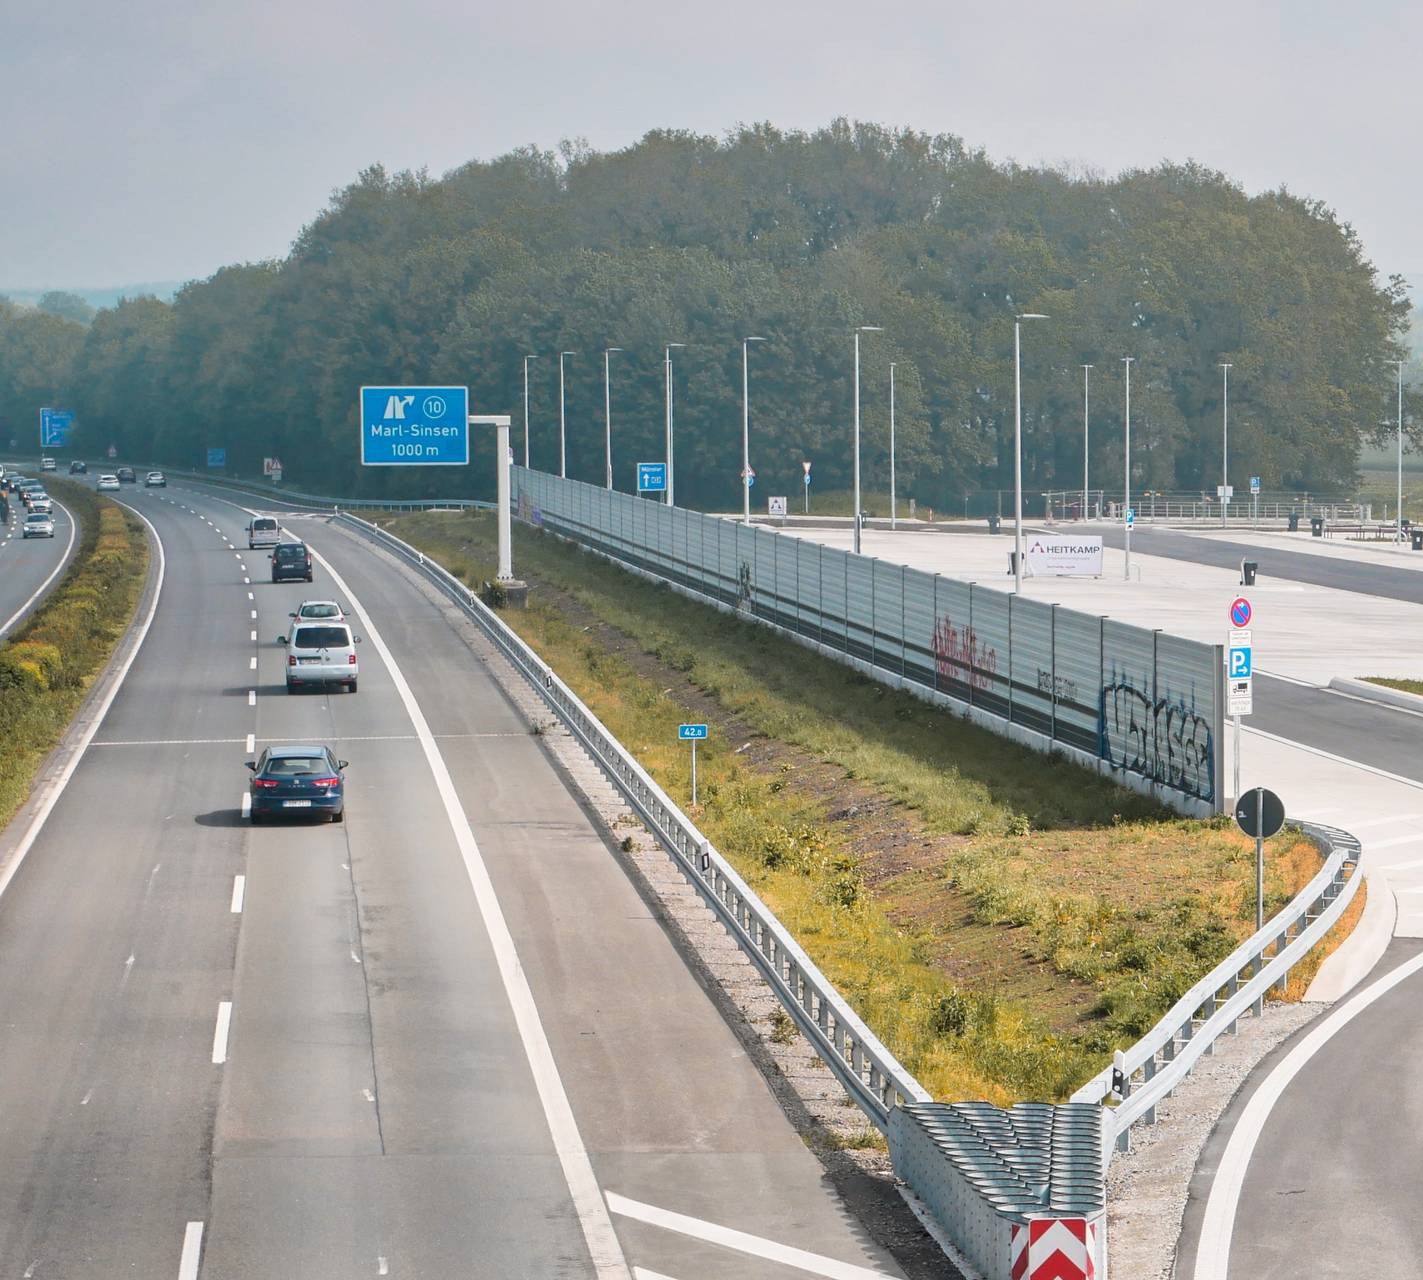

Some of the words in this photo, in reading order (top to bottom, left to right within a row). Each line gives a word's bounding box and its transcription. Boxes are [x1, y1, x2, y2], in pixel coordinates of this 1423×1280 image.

[429, 401, 441, 414] 10
[371, 424, 458, 437] Marl-Sinsen
[392, 444, 422, 456] 1000
[426, 446, 439, 456] m
[1046, 546, 1100, 554] HEITKAMP
[1232, 651, 1245, 675] P
